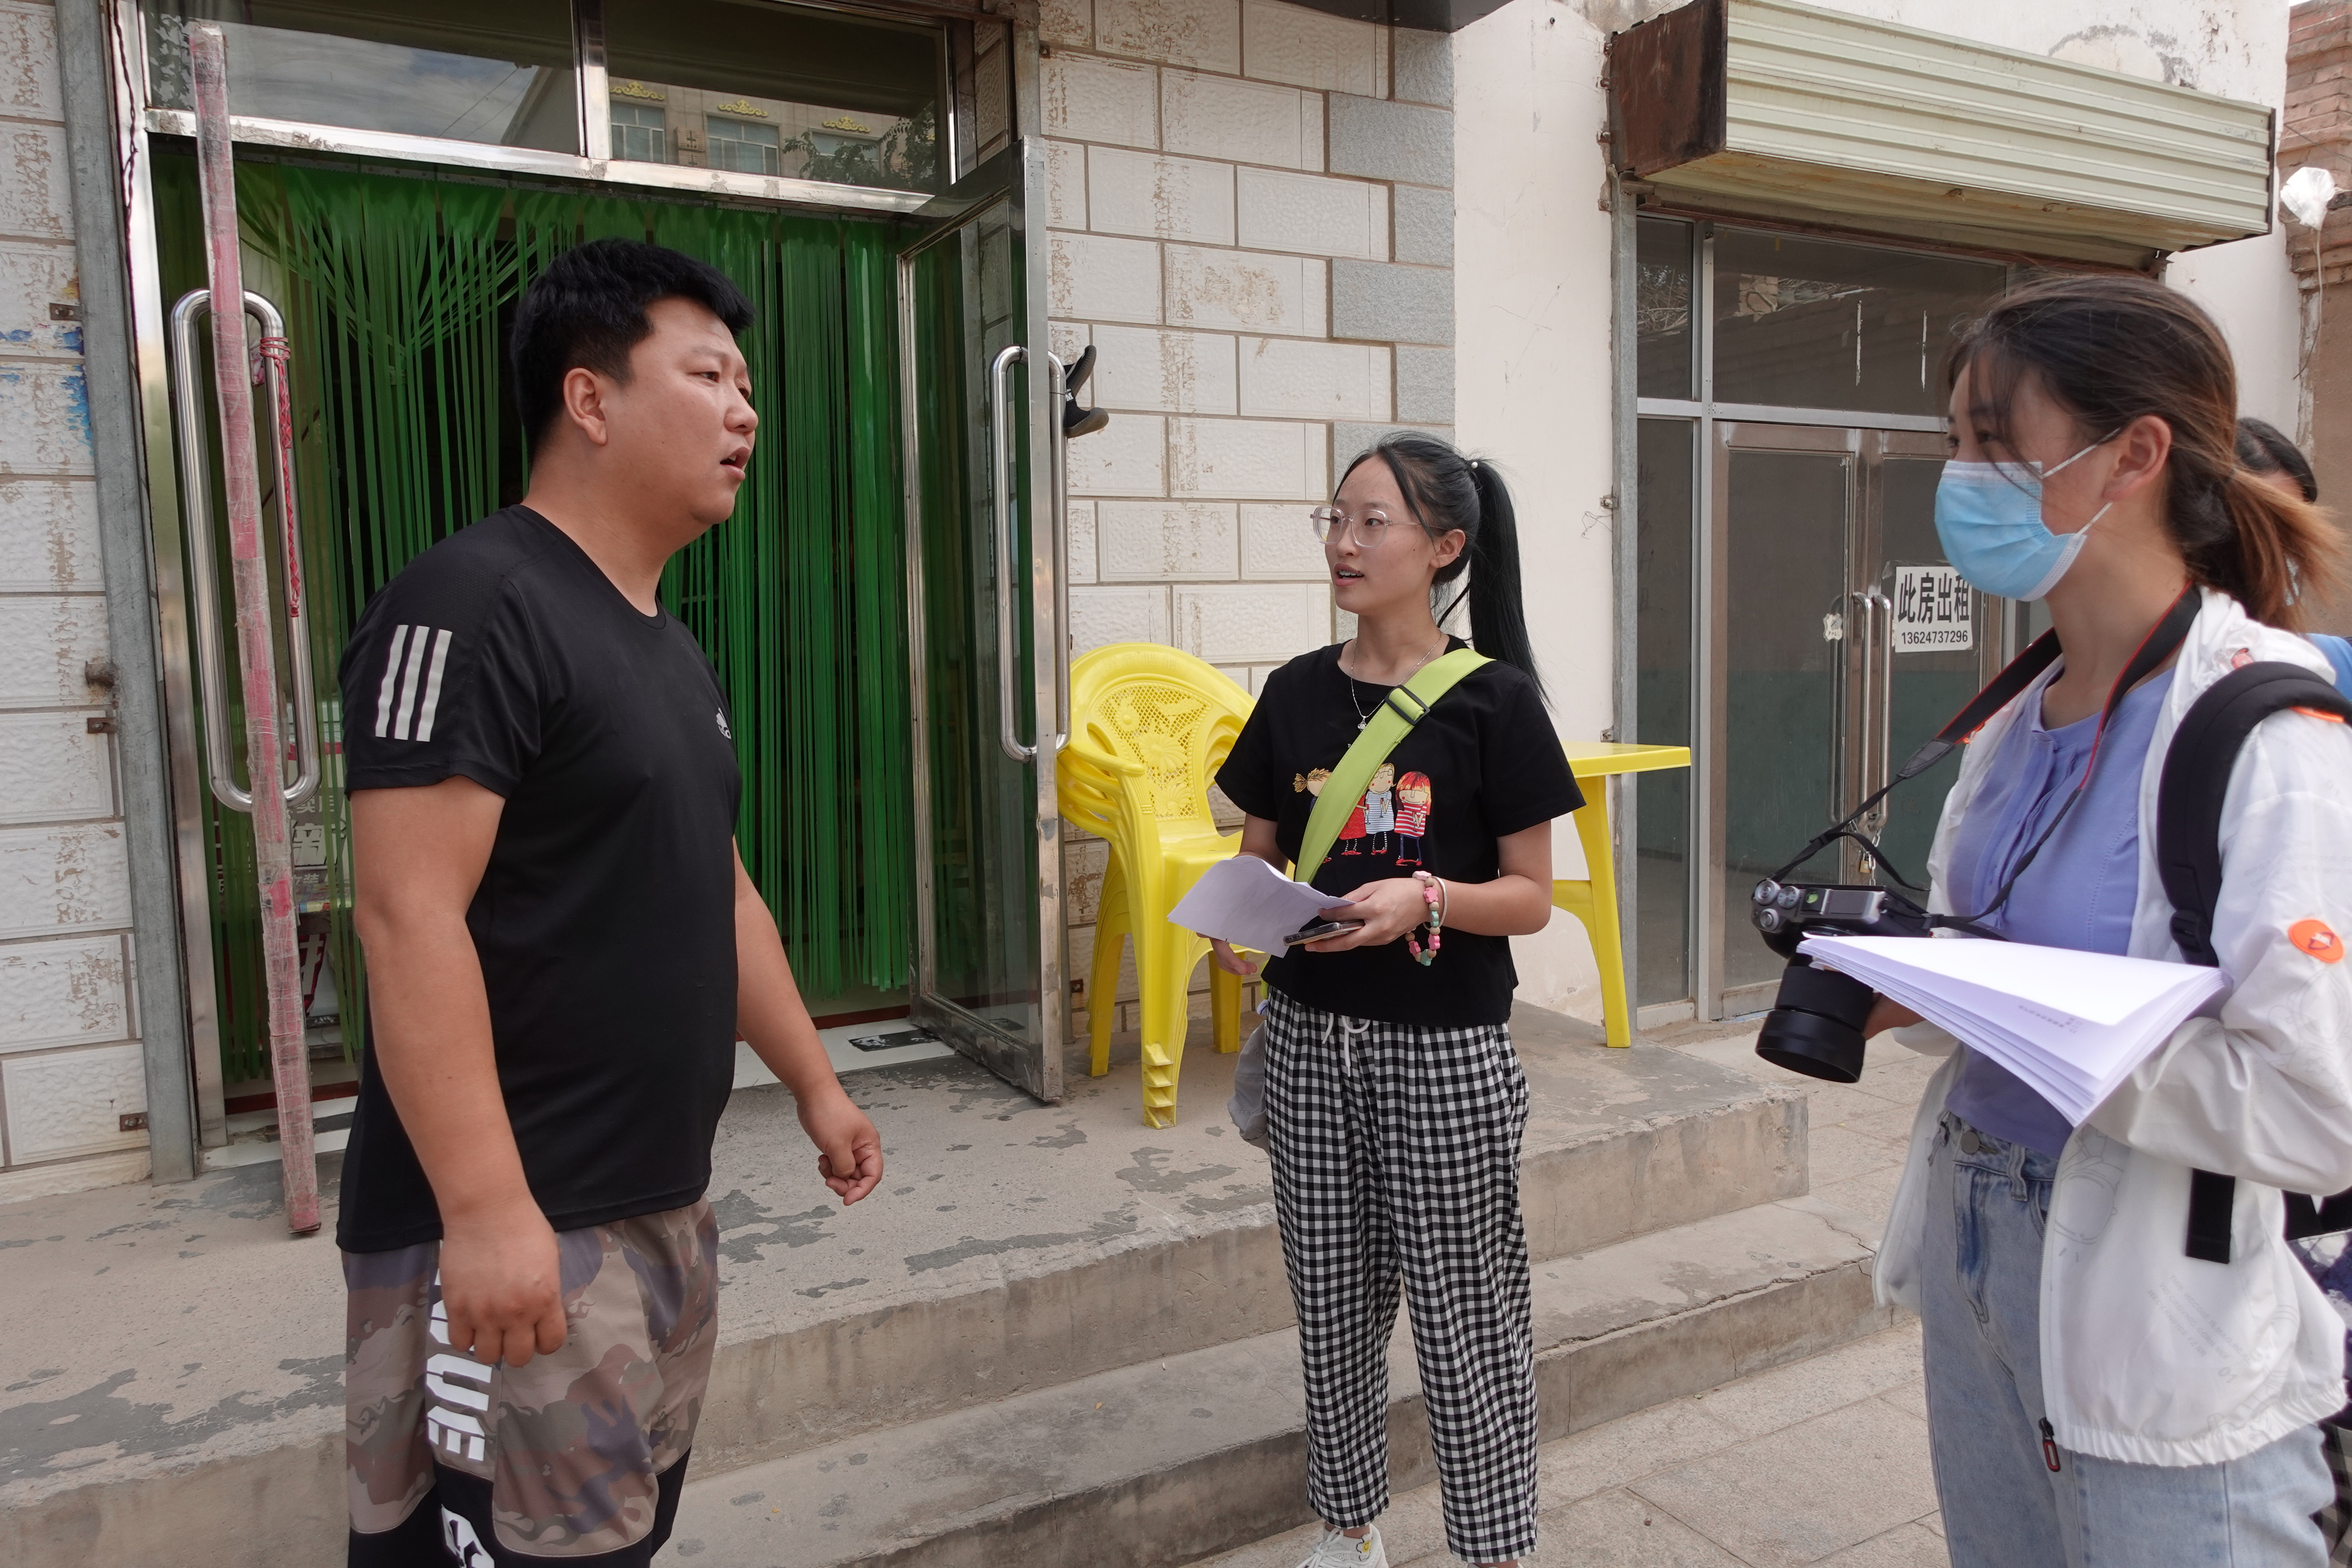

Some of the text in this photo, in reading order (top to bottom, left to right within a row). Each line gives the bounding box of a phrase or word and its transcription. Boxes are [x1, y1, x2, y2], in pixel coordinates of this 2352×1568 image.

[1898, 572, 1969, 624] 此房出租
[1902, 630, 1968, 644] 13624737296
